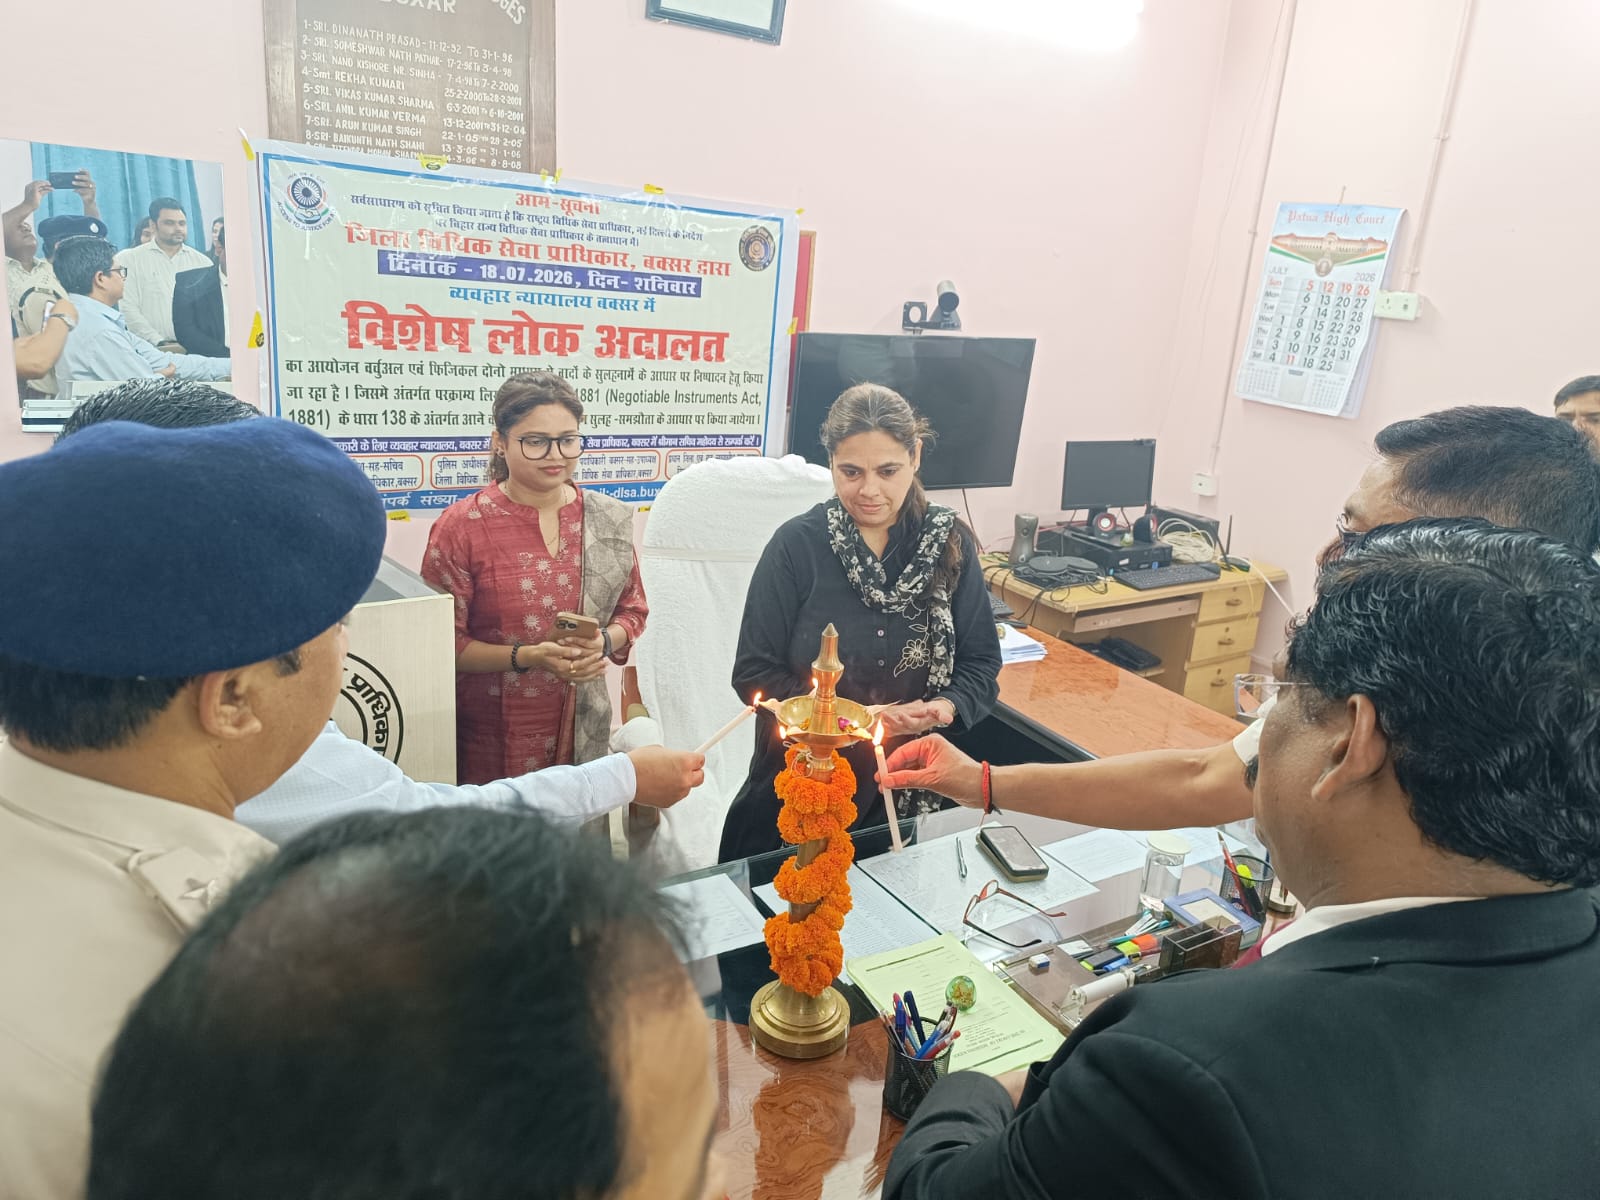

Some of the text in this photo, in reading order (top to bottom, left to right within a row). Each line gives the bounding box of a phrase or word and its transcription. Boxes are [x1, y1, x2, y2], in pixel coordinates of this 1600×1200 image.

[332, 23, 384, 42] DINANATH
[334, 39, 386, 57] SOMESHWAR
[389, 48, 412, 61] NATH
[357, 59, 390, 73] KISHORE
[409, 67, 436, 80] SINHA
[334, 70, 367, 86] REKHA
[369, 76, 405, 91] KUMARI
[334, 87, 361, 100] VIKAS
[364, 91, 396, 105] KUMAR
[398, 95, 434, 110] SHARMA
[335, 103, 356, 116] ANIL
[359, 106, 390, 121] KUMAR
[392, 111, 426, 125] VERMA
[335, 118, 360, 131] ARUN
[362, 121, 393, 135] KUMAR
[395, 125, 422, 137] SINGH
[333, 132, 373, 147] BAIKUNTH
[375, 137, 398, 148] NATH
[400, 139, 425, 151] SHAHI
[351, 194, 405, 209] सर्वसाधारण
[408, 199, 420, 211] को
[424, 202, 450, 215] सूचित
[452, 204, 476, 216] किया
[516, 192, 600, 216] आम-सूचना
[1287, 210, 1385, 226] Patna High Court
[477, 222, 497, 232] राज्य
[530, 226, 547, 237] सेवा
[345, 221, 410, 249] जिला
[498, 237, 541, 260] सेवा
[547, 243, 636, 271] प्राधिकार,
[643, 255, 693, 273] बक्सर
[387, 252, 458, 276] दिनांक
[634, 275, 697, 295] शनिवार
[1354, 272, 1376, 282] 2026
[1306, 280, 1314, 291] 5
[1323, 281, 1334, 293] 12
[1341, 282, 1352, 294] 19
[1357, 284, 1370, 296] 26
[449, 286, 656, 312] व्यवहार न्यायालय बक्सर में
[1303, 293, 1310, 304] 6
[1320, 294, 1331, 306] 13
[1336, 296, 1350, 308] 20
[1354, 298, 1367, 309] 27
[1317, 307, 1328, 318] 14
[1334, 309, 1346, 321] 21
[1351, 311, 1363, 323] 28
[341, 299, 730, 363] विशेष लोक अदालत
[1296, 318, 1303, 329] 8
[1313, 320, 1325, 331] 15
[1329, 322, 1344, 334] 22
[1347, 324, 1360, 336] 29
[1275, 328, 1356, 348] 2 9 16 23 30
[1272, 340, 1279, 351] 3
[1288, 342, 1299, 353] 10
[1306, 344, 1318, 356] 17
[1323, 347, 1336, 359] 24
[285, 359, 303, 373] का
[308, 357, 360, 374] आयोजन
[364, 359, 404, 379] वर्चुअल
[408, 360, 424, 375] एवं
[429, 361, 478, 377] फिजिकल
[582, 365, 592, 380] के
[638, 368, 647, 381] के
[650, 370, 677, 382] आधार
[680, 371, 690, 381] पर
[743, 370, 763, 384] किया
[1269, 352, 1333, 372] 4 18 25
[286, 386, 304, 399] जा
[308, 387, 327, 402] रहा
[330, 384, 340, 402] है
[354, 384, 389, 400] जिसमे
[393, 385, 431, 401] अंतर्गत
[435, 389, 475, 403] परक्राम्य
[605, 389, 670, 406] (Negotiable
[674, 389, 738, 404] Instruments
[338, 410, 350, 425] के
[353, 412, 378, 425] धारा
[381, 409, 407, 425] 138
[409, 411, 421, 425] के
[424, 410, 459, 425] अंतर्गत
[462, 411, 485, 425] आने
[590, 414, 612, 428] सुलह
[657, 411, 665, 425] के
[667, 414, 693, 425] आधार
[695, 414, 705, 425] पर
[707, 411, 727, 425] किया
[360, 439, 369, 451] के
[372, 438, 388, 451] लिए
[390, 441, 419, 451] व्यवहार
[459, 440, 482, 450] बक्सर
[420, 491, 458, 506] संख्या
